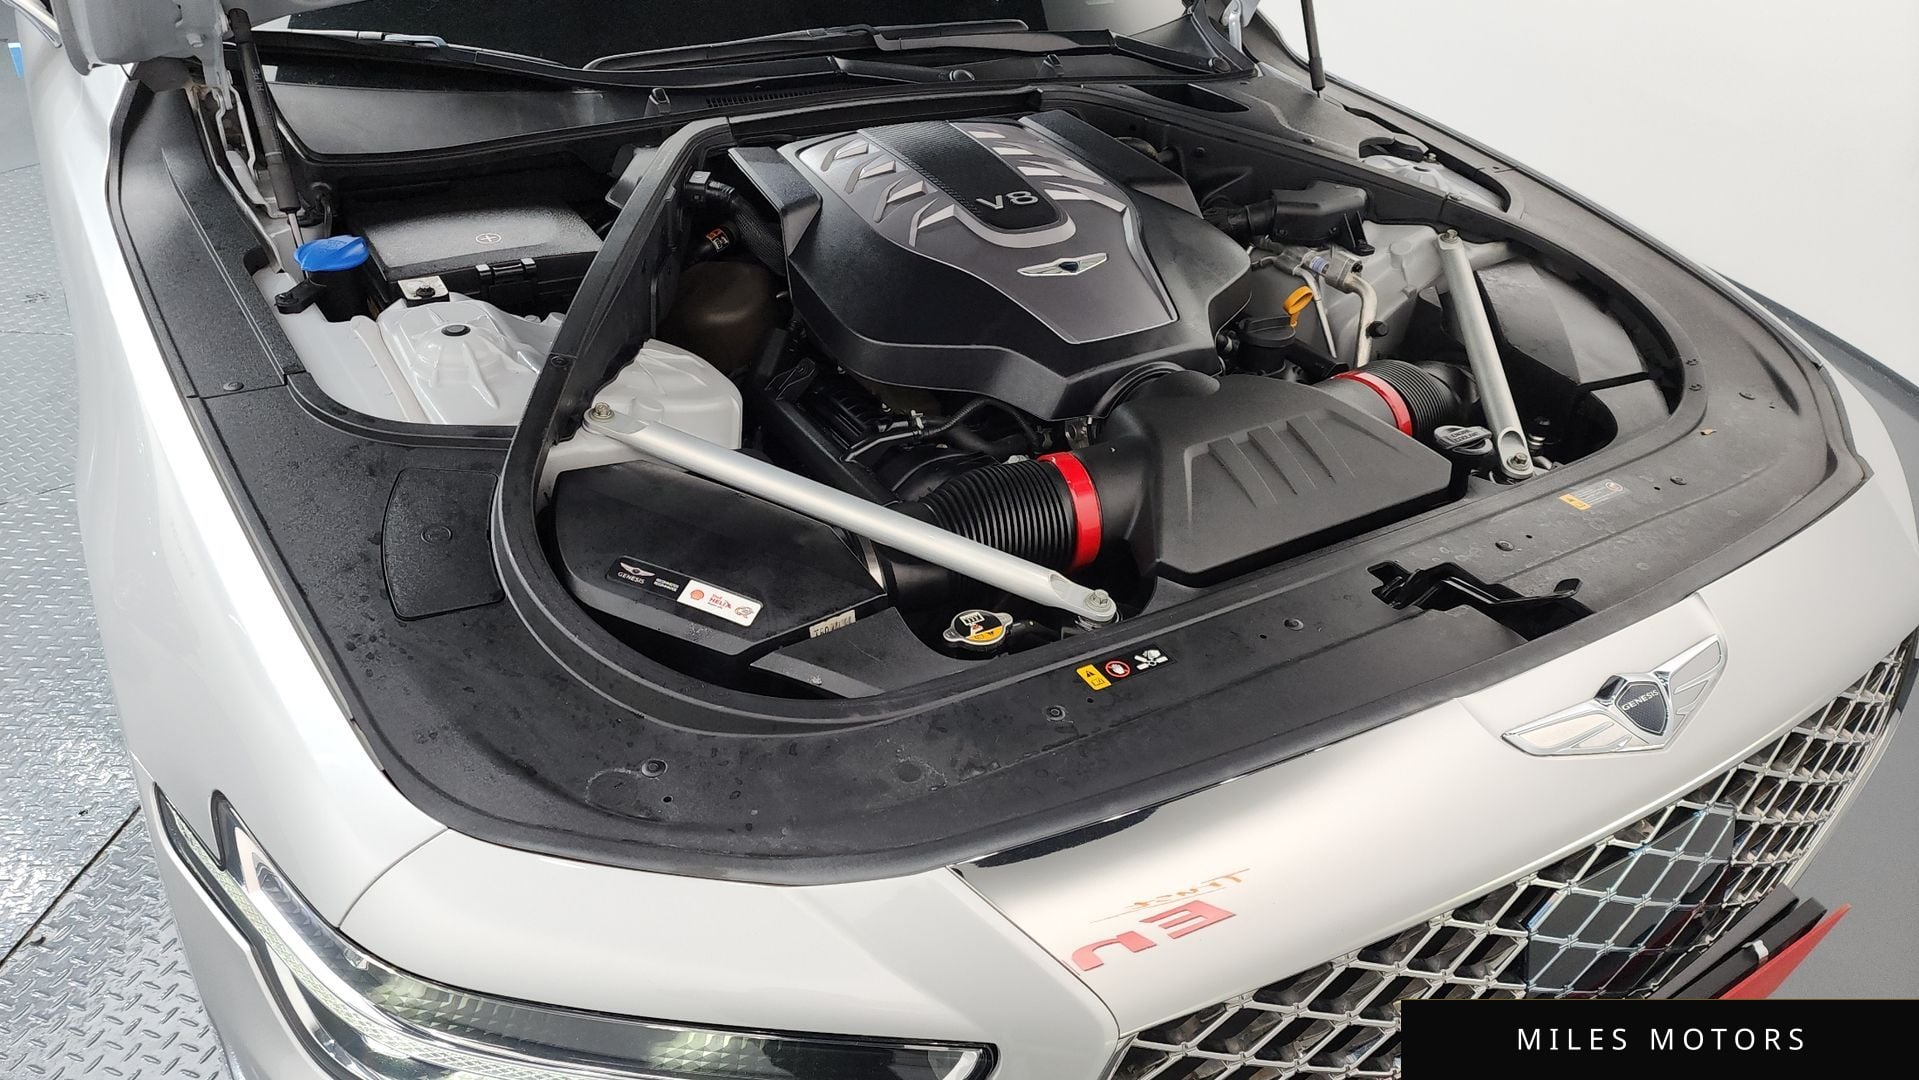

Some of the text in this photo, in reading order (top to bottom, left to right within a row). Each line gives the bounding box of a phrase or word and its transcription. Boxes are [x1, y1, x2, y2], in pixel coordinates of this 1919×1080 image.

[975, 190, 1039, 210] V8
[617, 571, 646, 585] GENESIS
[709, 597, 732, 609] HELIX
[1621, 689, 1659, 711] GENESIS
